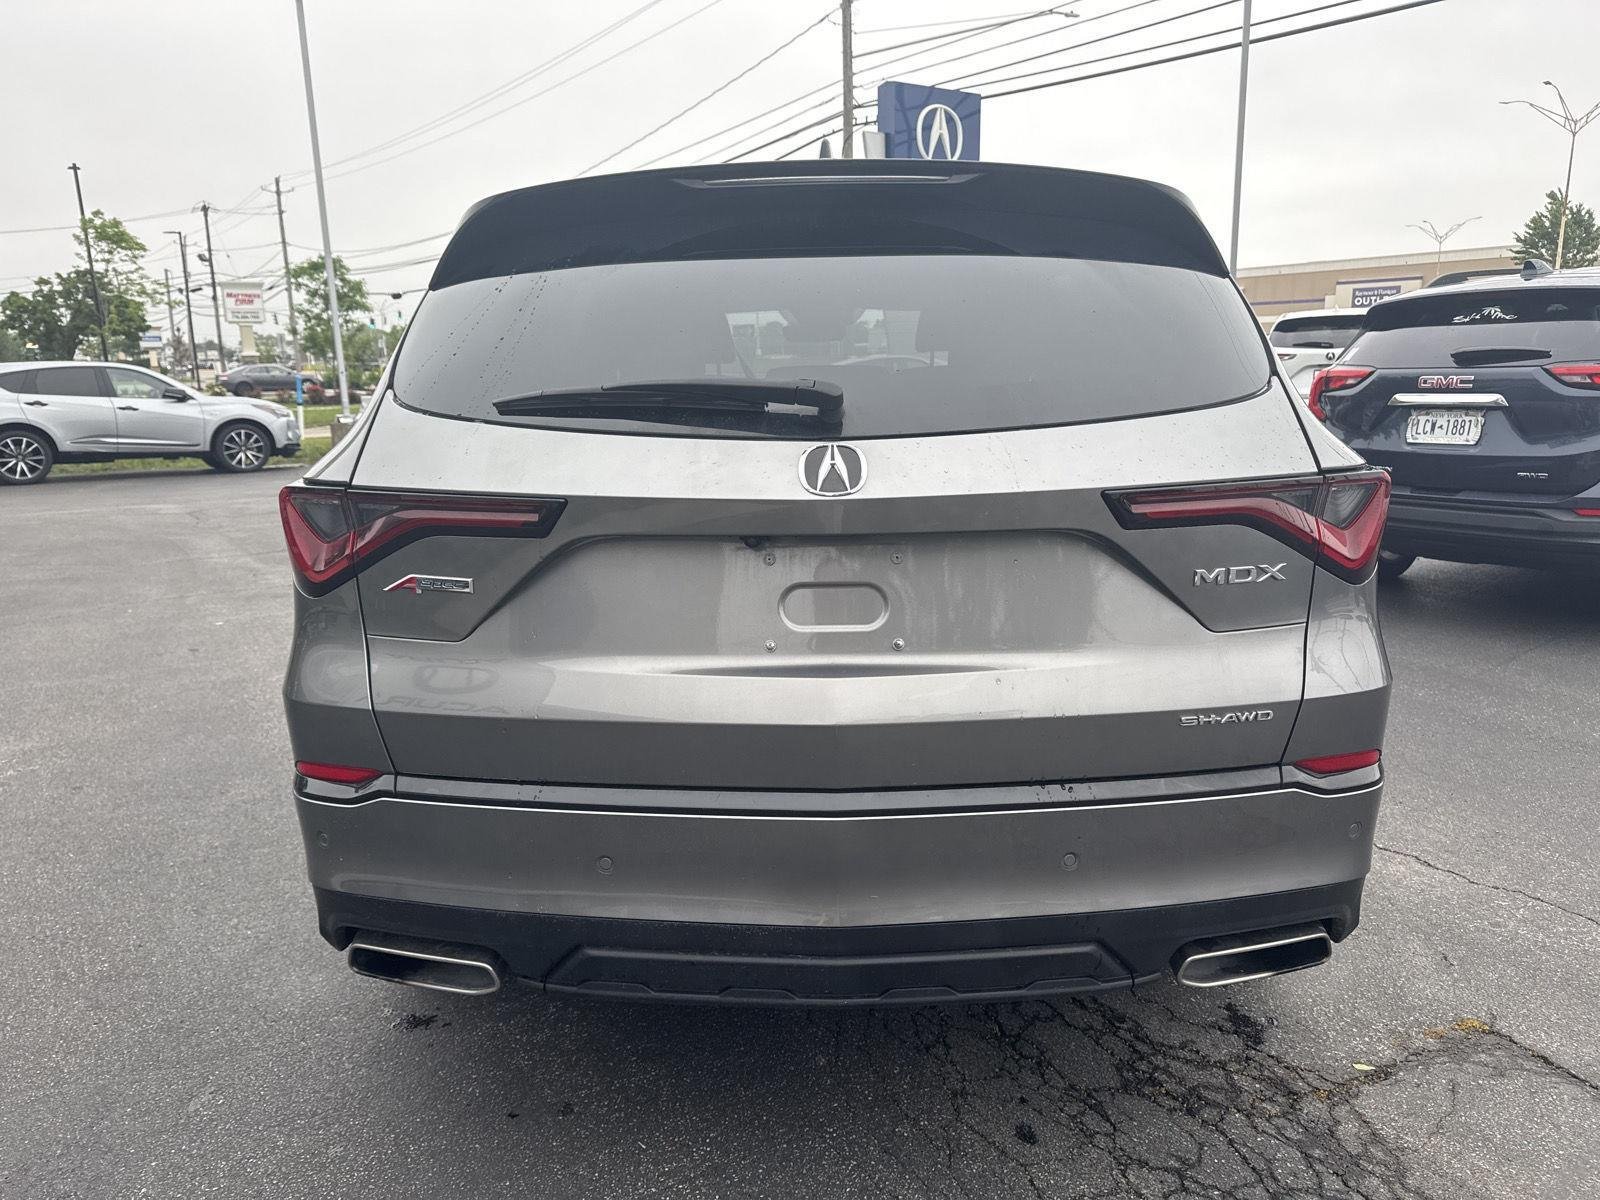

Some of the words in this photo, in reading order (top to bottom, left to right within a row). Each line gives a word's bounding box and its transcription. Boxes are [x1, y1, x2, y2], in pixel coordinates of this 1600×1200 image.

[1354, 295, 1389, 306] OUTL
[1418, 375, 1475, 389] GMC
[1447, 411, 1464, 419] YORK
[1193, 562, 1288, 587] MDX
[1179, 710, 1275, 727] SH-AWD
